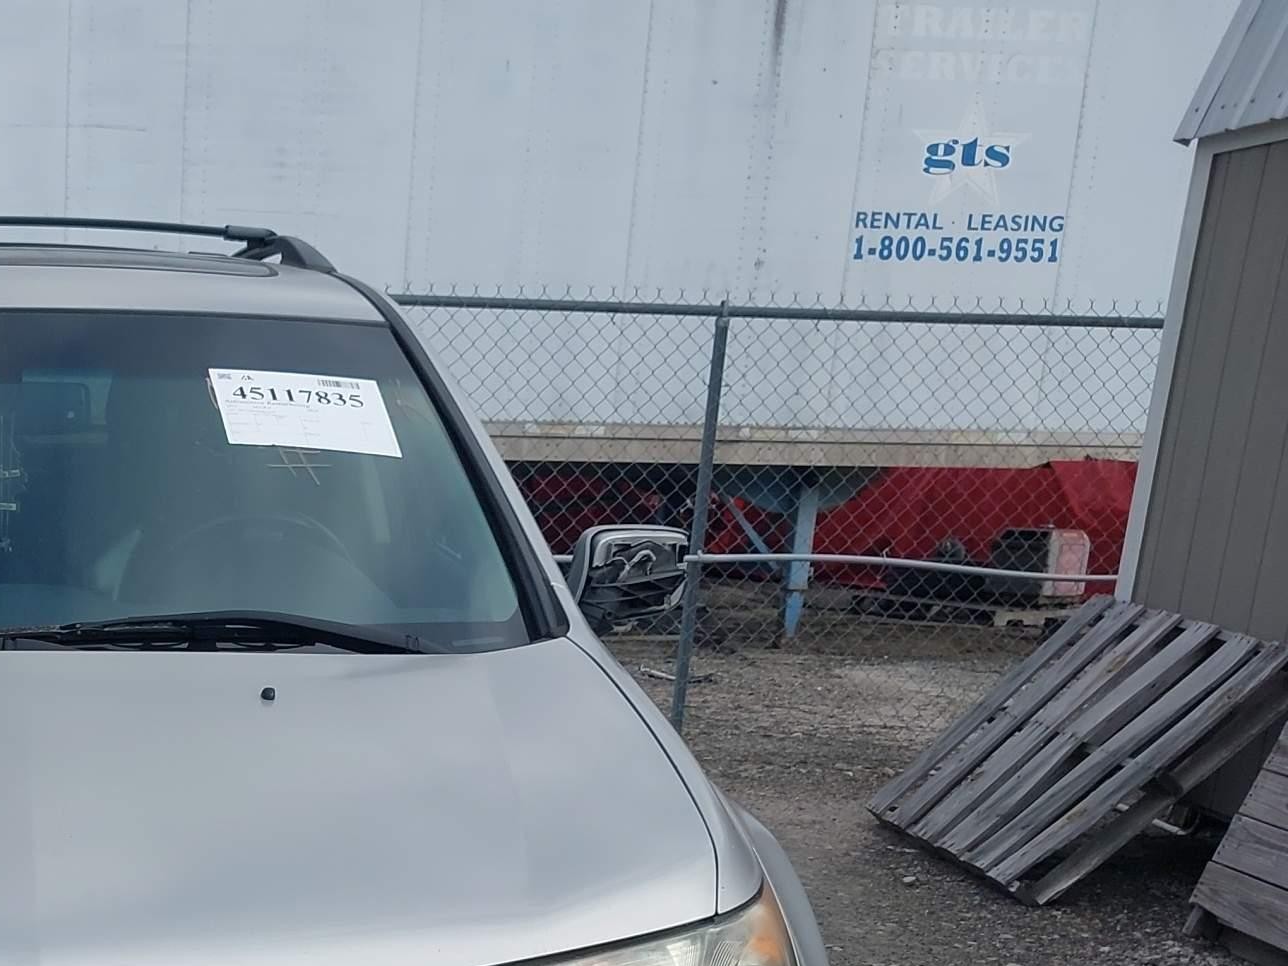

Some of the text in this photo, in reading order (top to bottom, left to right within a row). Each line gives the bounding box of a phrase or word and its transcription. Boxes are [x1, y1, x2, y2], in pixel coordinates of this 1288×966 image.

[922, 136, 1011, 176] gts
[854, 211, 943, 232] RENTAL
[966, 212, 1065, 234] LEASING
[852, 235, 1059, 264] 1-800-561-9551
[231, 385, 365, 409] 45117835
